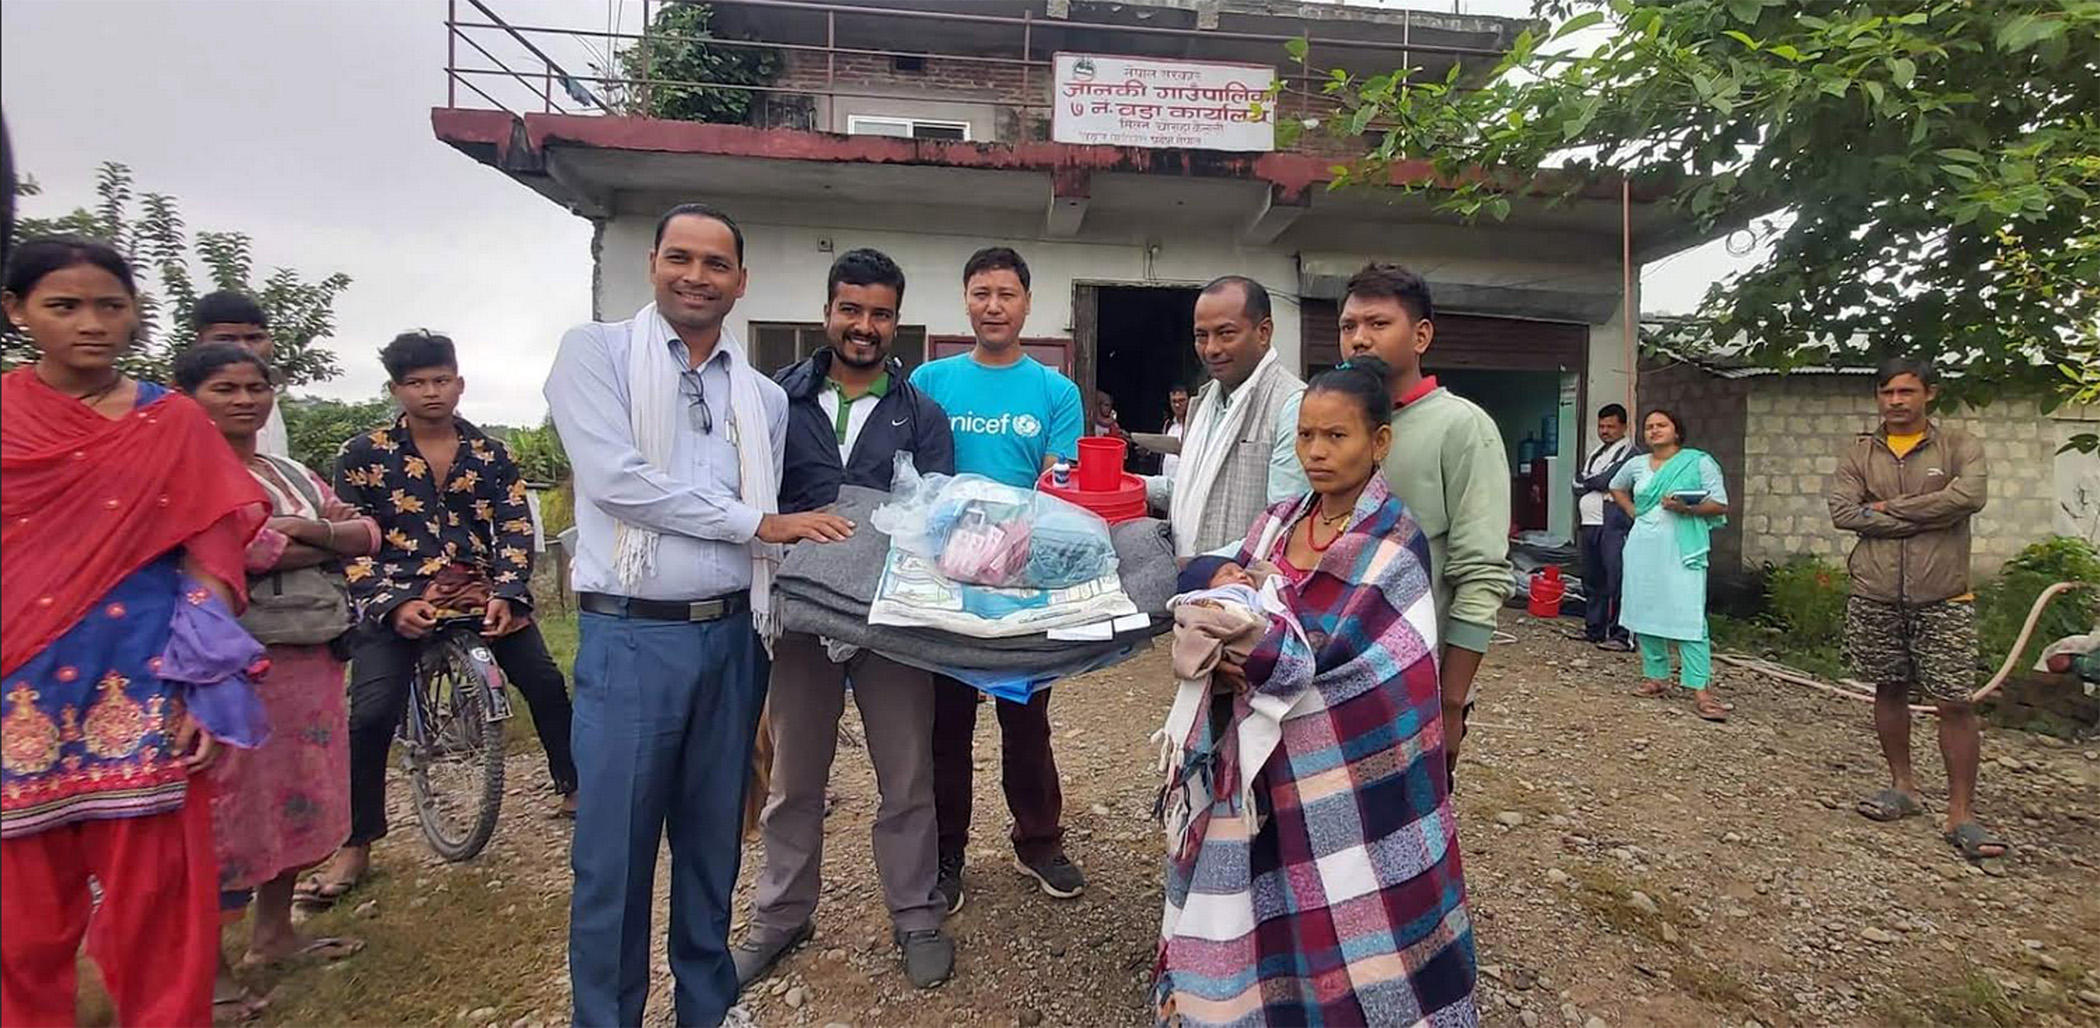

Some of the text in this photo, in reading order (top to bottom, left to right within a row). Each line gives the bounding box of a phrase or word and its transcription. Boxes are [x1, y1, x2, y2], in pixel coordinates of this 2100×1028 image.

[1062, 79, 1148, 97] जानकी
[1070, 102, 1084, 117] ७
[1115, 103, 1163, 120] वडा
[1167, 104, 1271, 123] कार्यालय
[948, 410, 1011, 435] nicef
